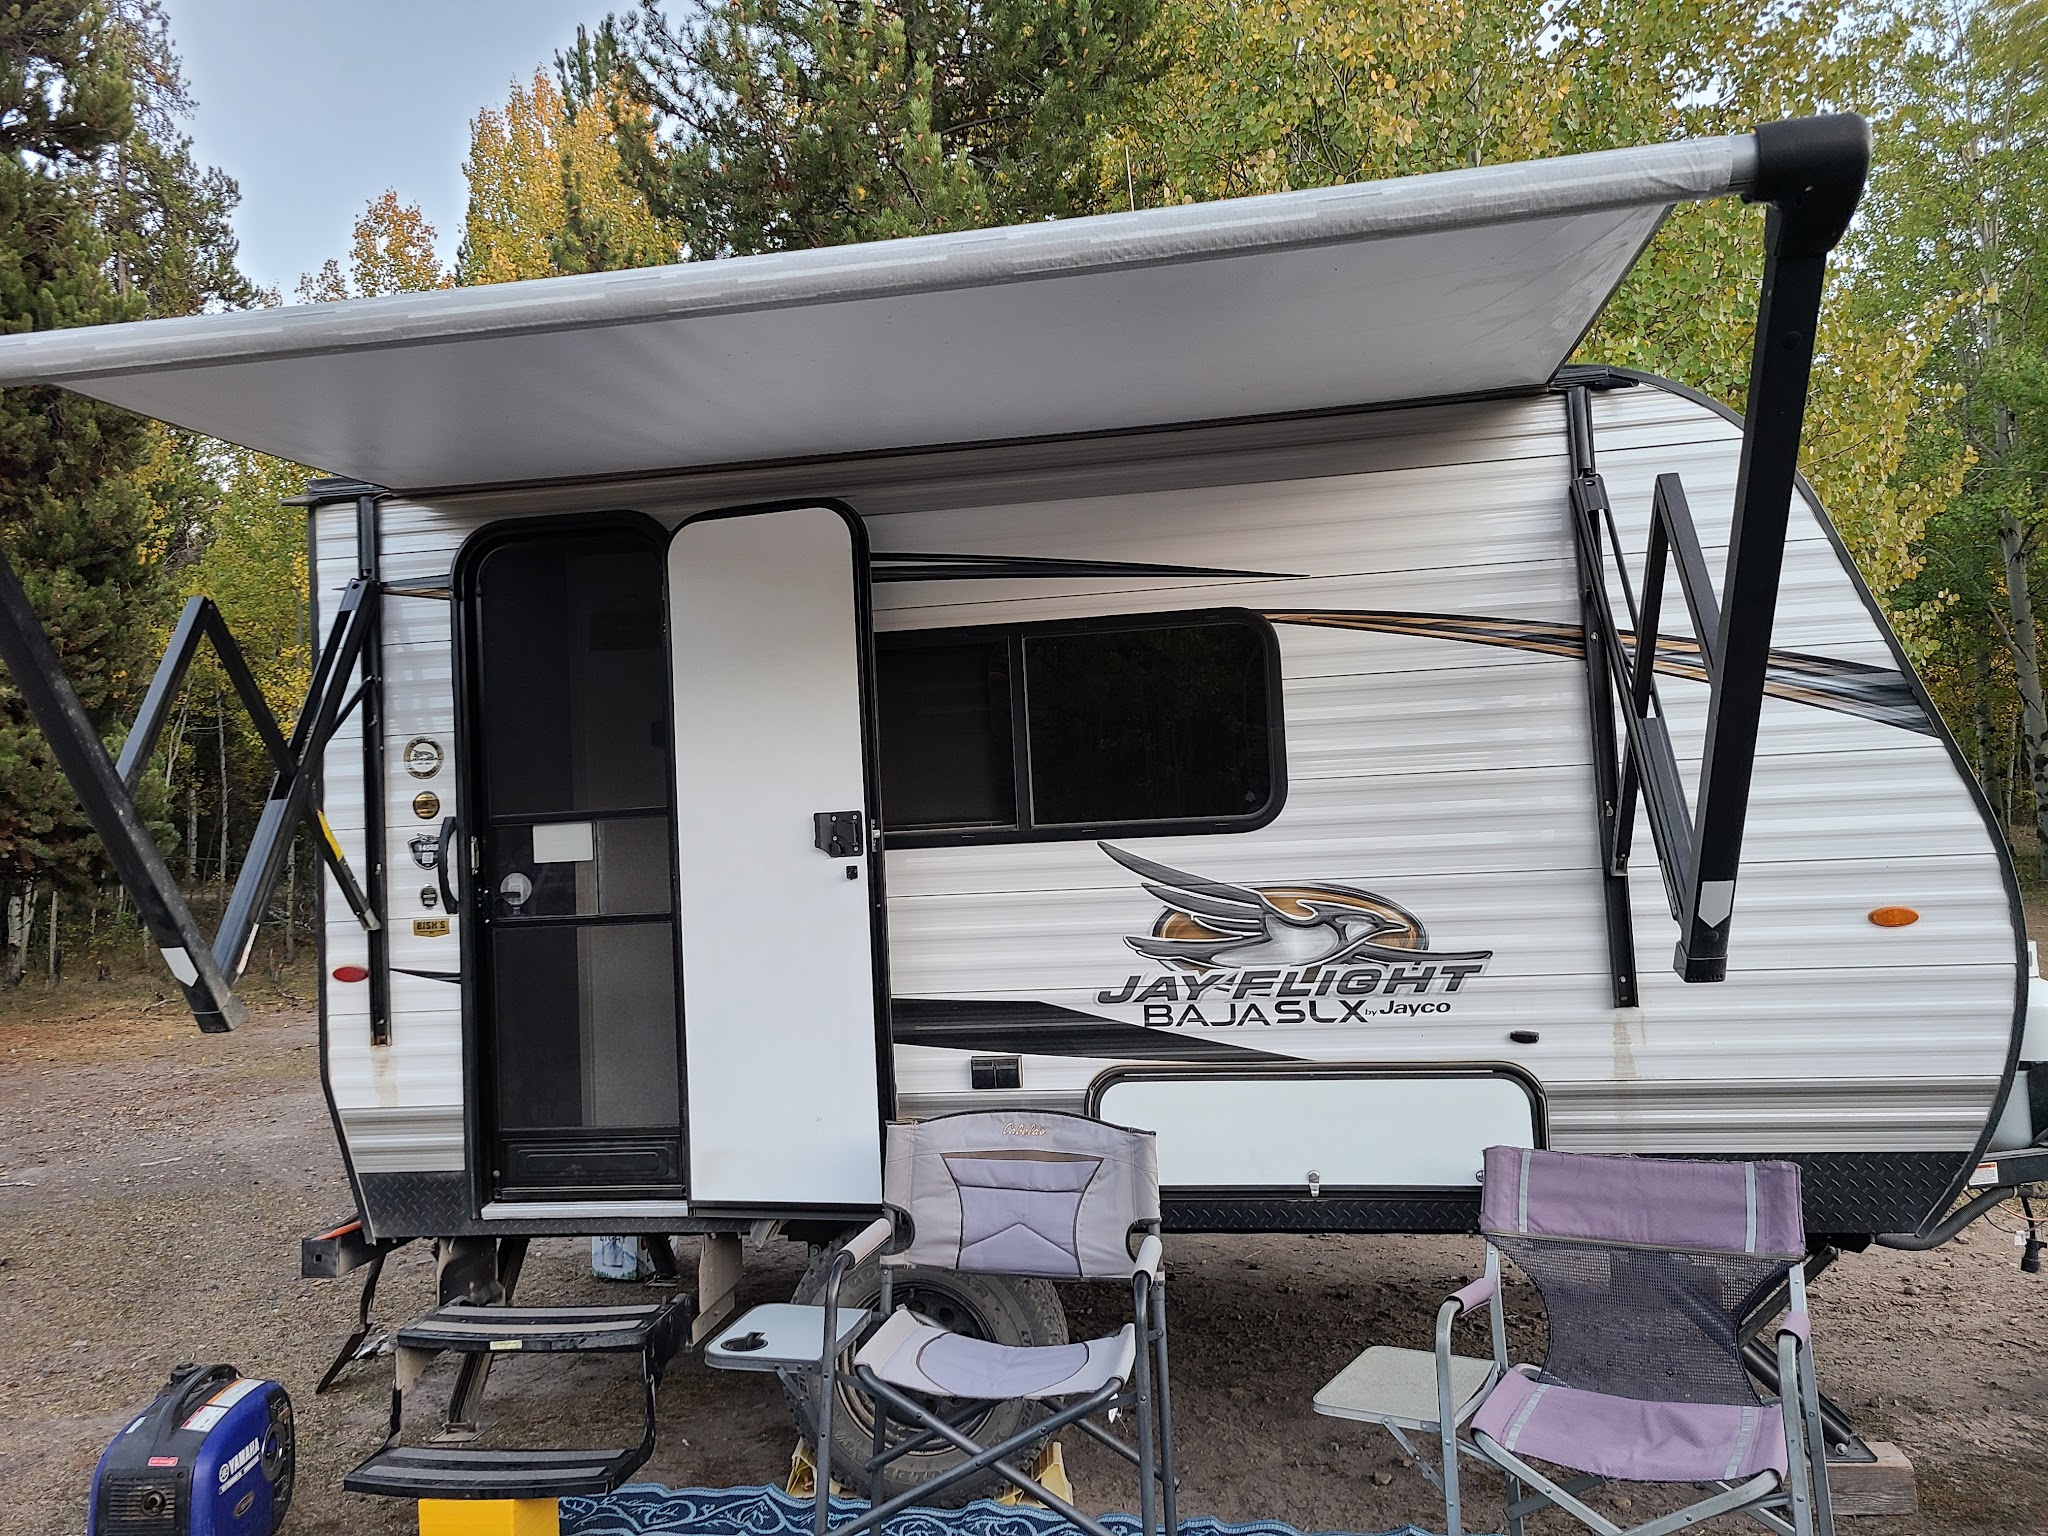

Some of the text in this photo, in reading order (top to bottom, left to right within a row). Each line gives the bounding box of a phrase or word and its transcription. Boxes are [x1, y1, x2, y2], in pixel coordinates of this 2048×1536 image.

[1097, 964, 1484, 1004] JAY FLIGHT
[1364, 1008, 1378, 1017] by
[1379, 1000, 1451, 1018] Jayco
[228, 1436, 260, 1476] YAMAHA
